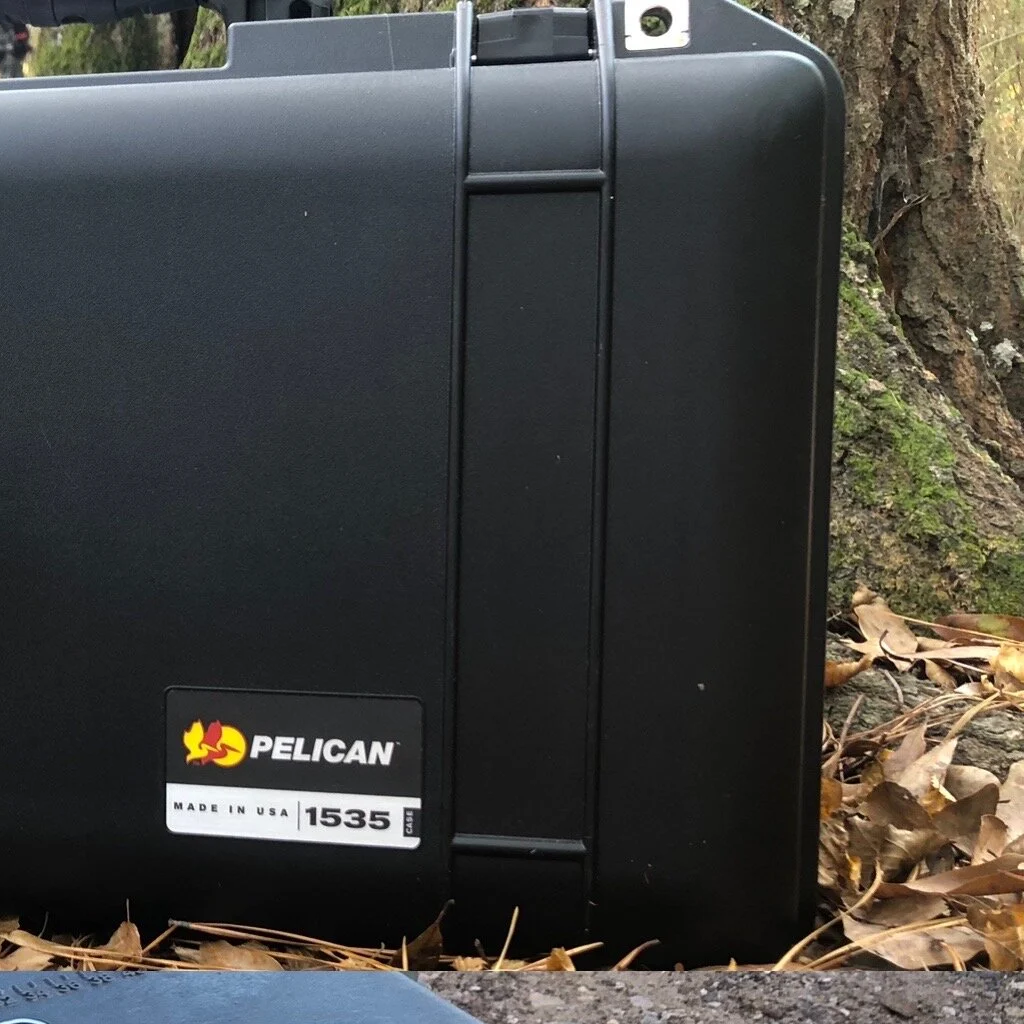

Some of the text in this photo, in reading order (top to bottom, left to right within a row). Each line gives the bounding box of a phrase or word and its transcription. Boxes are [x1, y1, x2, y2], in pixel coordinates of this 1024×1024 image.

[250, 735, 394, 766] PELICAN
[173, 801, 290, 818] MADE IN USA
[305, 806, 392, 831] 1535
[405, 809, 414, 835] CASE
